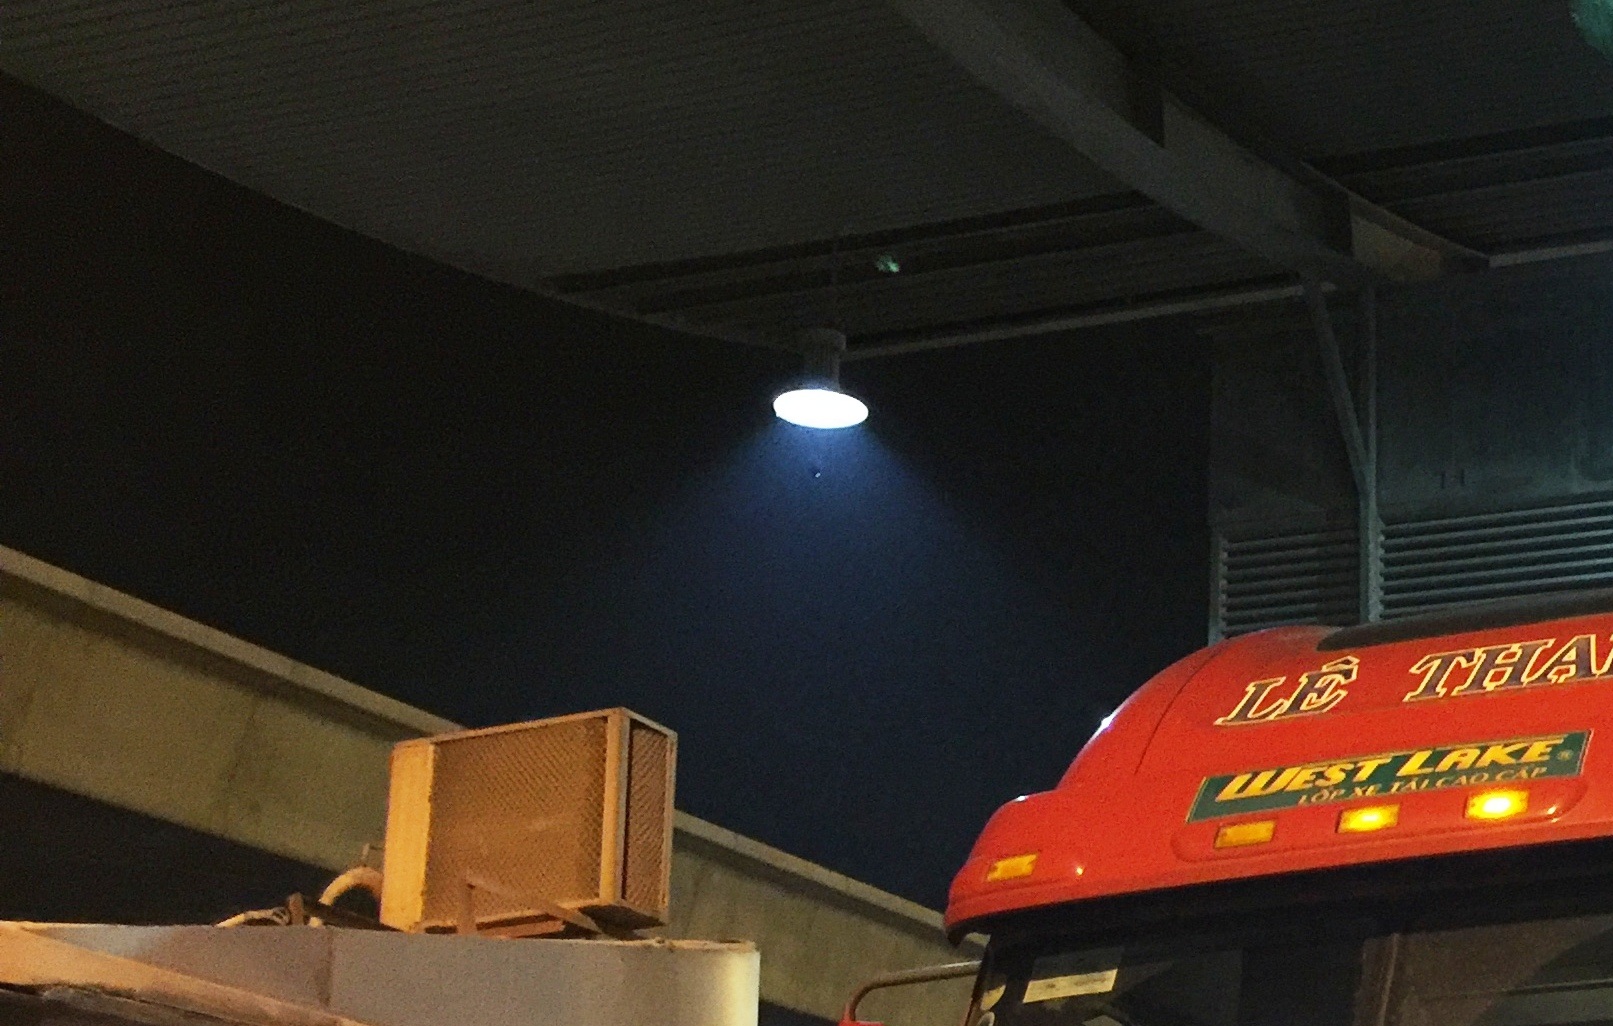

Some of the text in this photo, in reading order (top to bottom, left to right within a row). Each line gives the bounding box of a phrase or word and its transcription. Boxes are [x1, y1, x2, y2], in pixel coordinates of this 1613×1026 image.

[1213, 655, 1361, 726] LÊ
[1215, 735, 1564, 803] WEST LAKE
[1435, 771, 1488, 789] CAO
